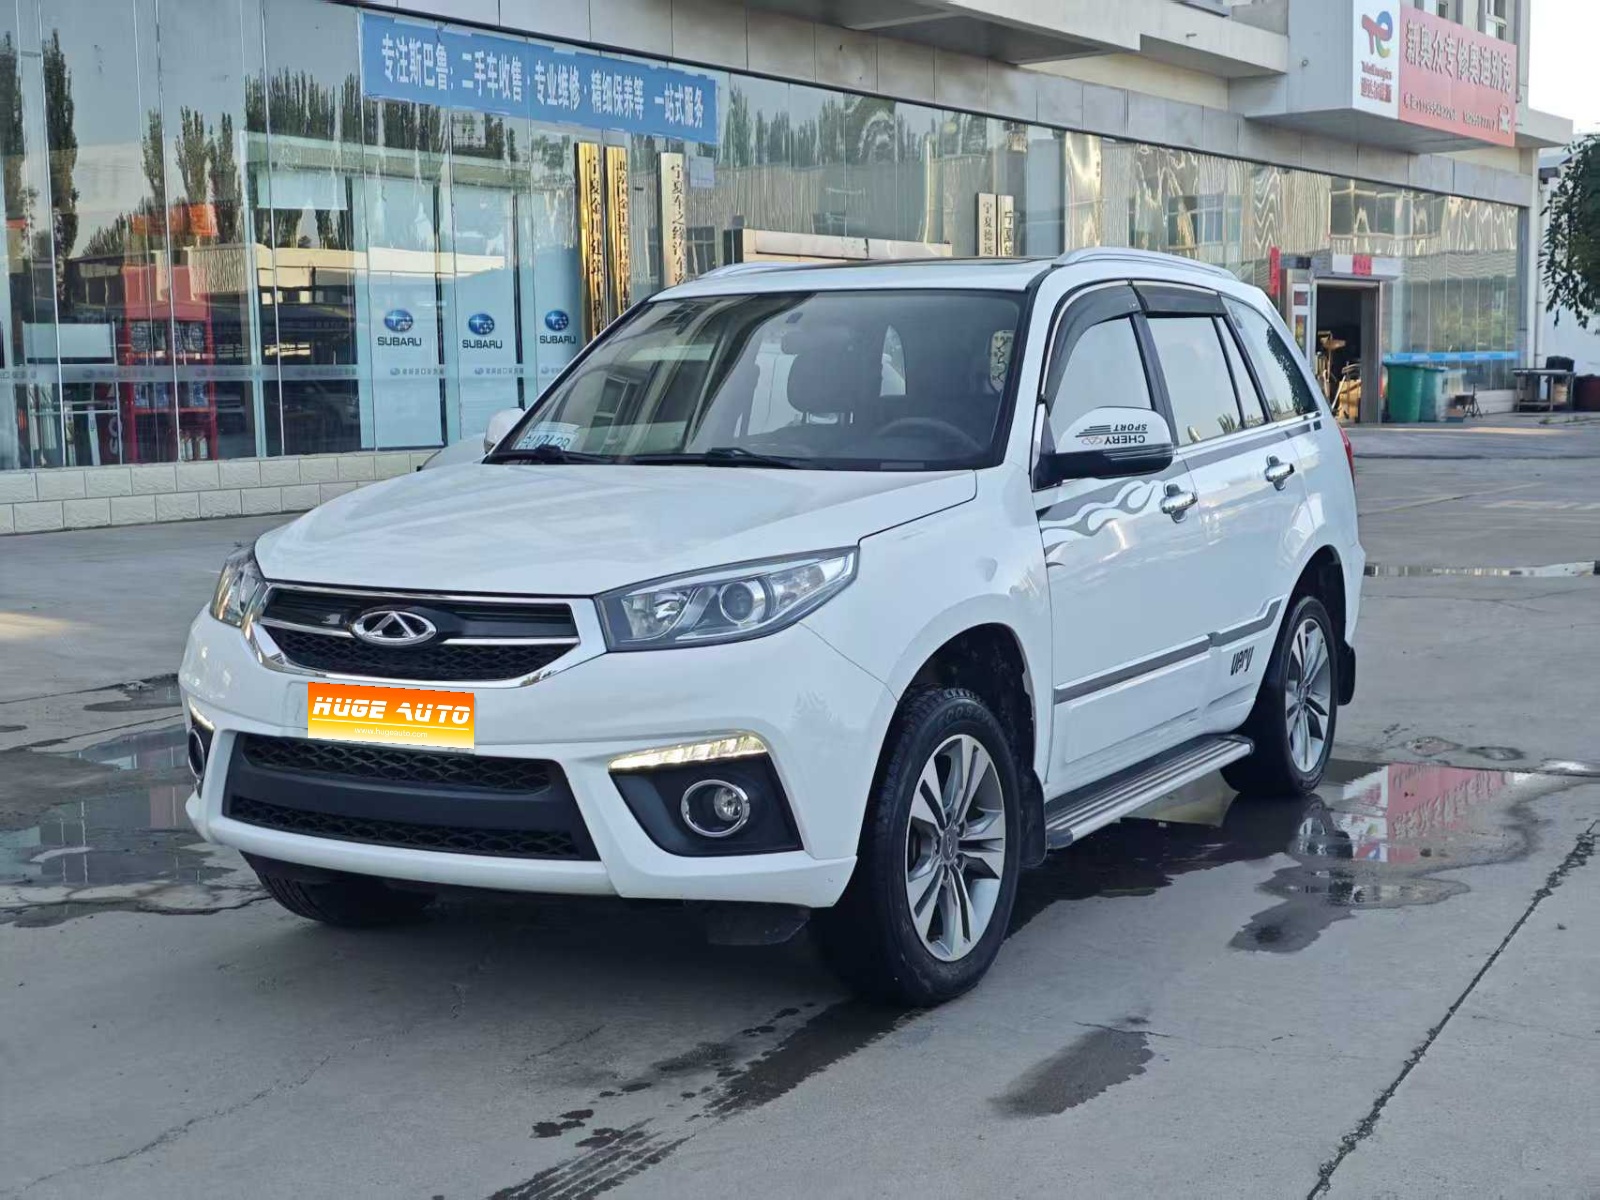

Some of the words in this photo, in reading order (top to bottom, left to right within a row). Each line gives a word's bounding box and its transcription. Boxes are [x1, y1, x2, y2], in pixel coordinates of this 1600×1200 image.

[654, 82, 704, 129] 一站式服务
[377, 336, 422, 347] SUBARU
[462, 339, 503, 349] SUBARU
[539, 335, 576, 345] SUBARU
[1104, 435, 1145, 444] CHERY
